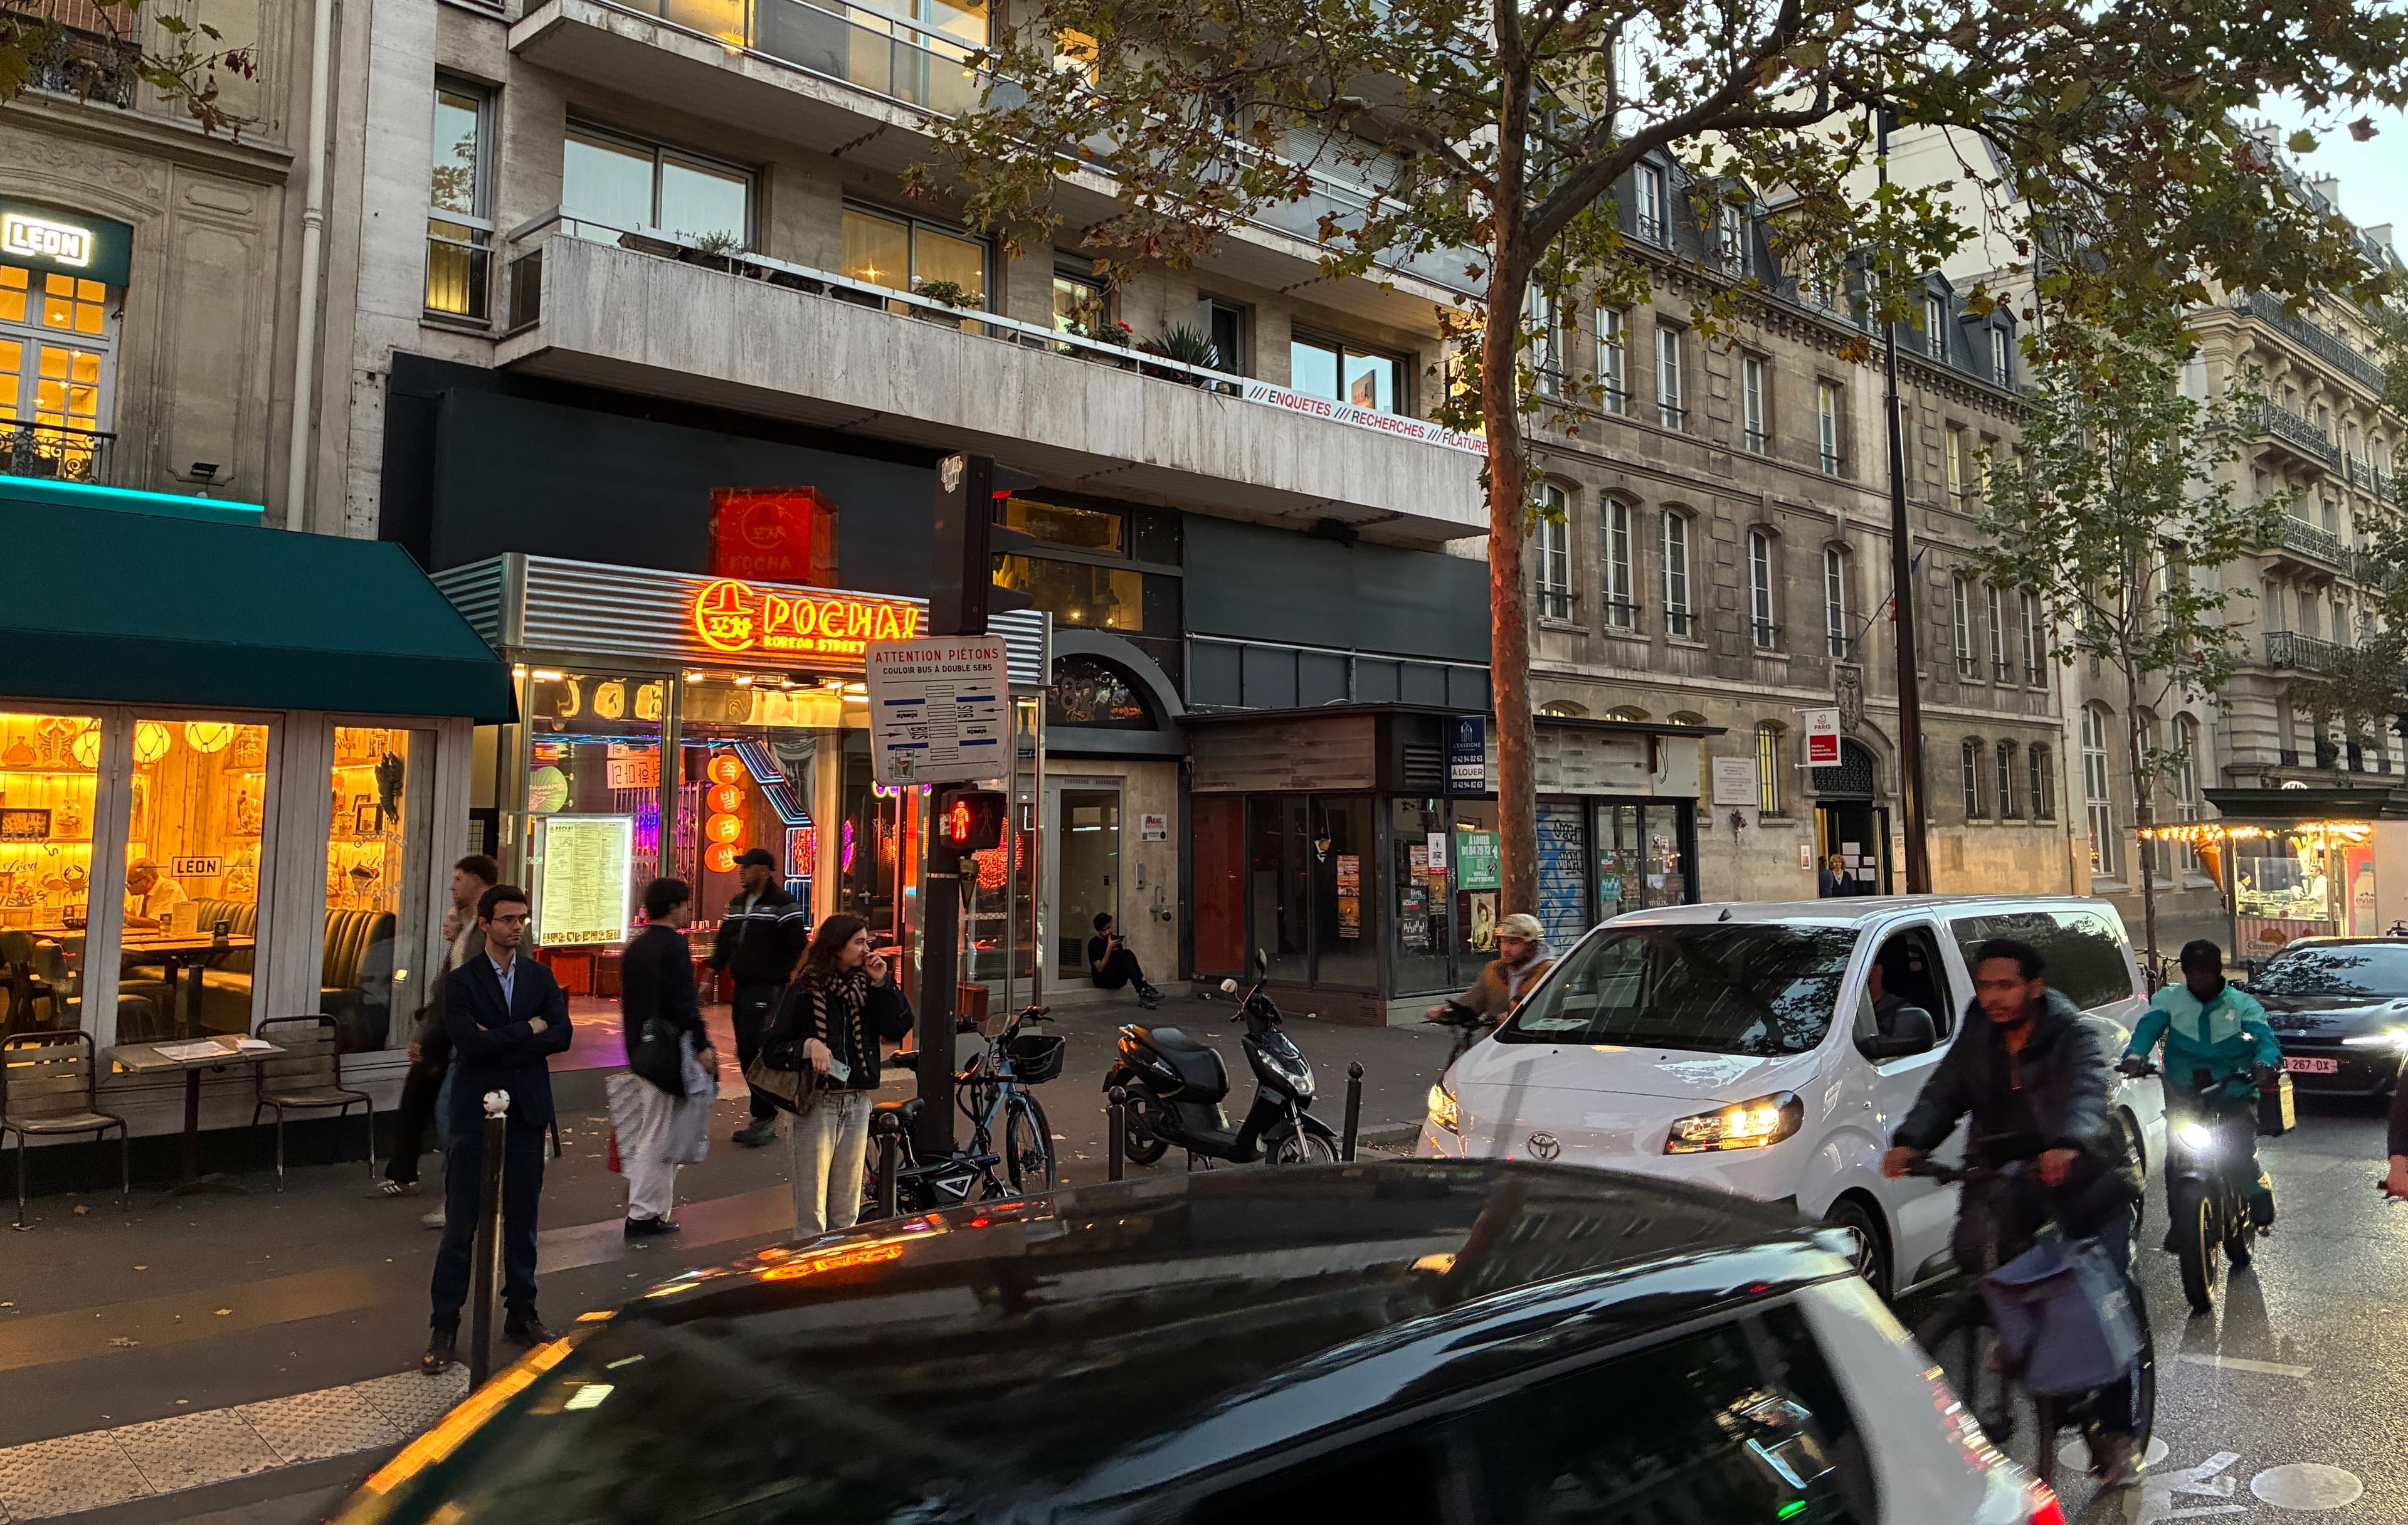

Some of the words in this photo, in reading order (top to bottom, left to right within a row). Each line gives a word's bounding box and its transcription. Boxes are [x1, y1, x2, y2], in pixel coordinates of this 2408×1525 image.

[1268, 390, 1331, 416] ENQUETES
[1352, 411, 1425, 438] RECHERCHES
[1443, 433, 1489, 453] FILATURE
[764, 594, 919, 640] POCHA!
[764, 635, 815, 649] KOREAN
[817, 638, 867, 653] STREET
[875, 650, 941, 663] ATTENTION
[949, 647, 999, 661] PIÉTONS
[883, 667, 915, 675] COULOIR
[917, 666, 932, 674] BUS
[934, 664, 940, 673] À
[943, 664, 971, 672] DOUBLE
[973, 663, 993, 672] SENS
[957, 705, 974, 718] BUS
[911, 726, 929, 740] BUS
[1452, 767, 1457, 776] À
[1474, 835, 1490, 845] LOUER
